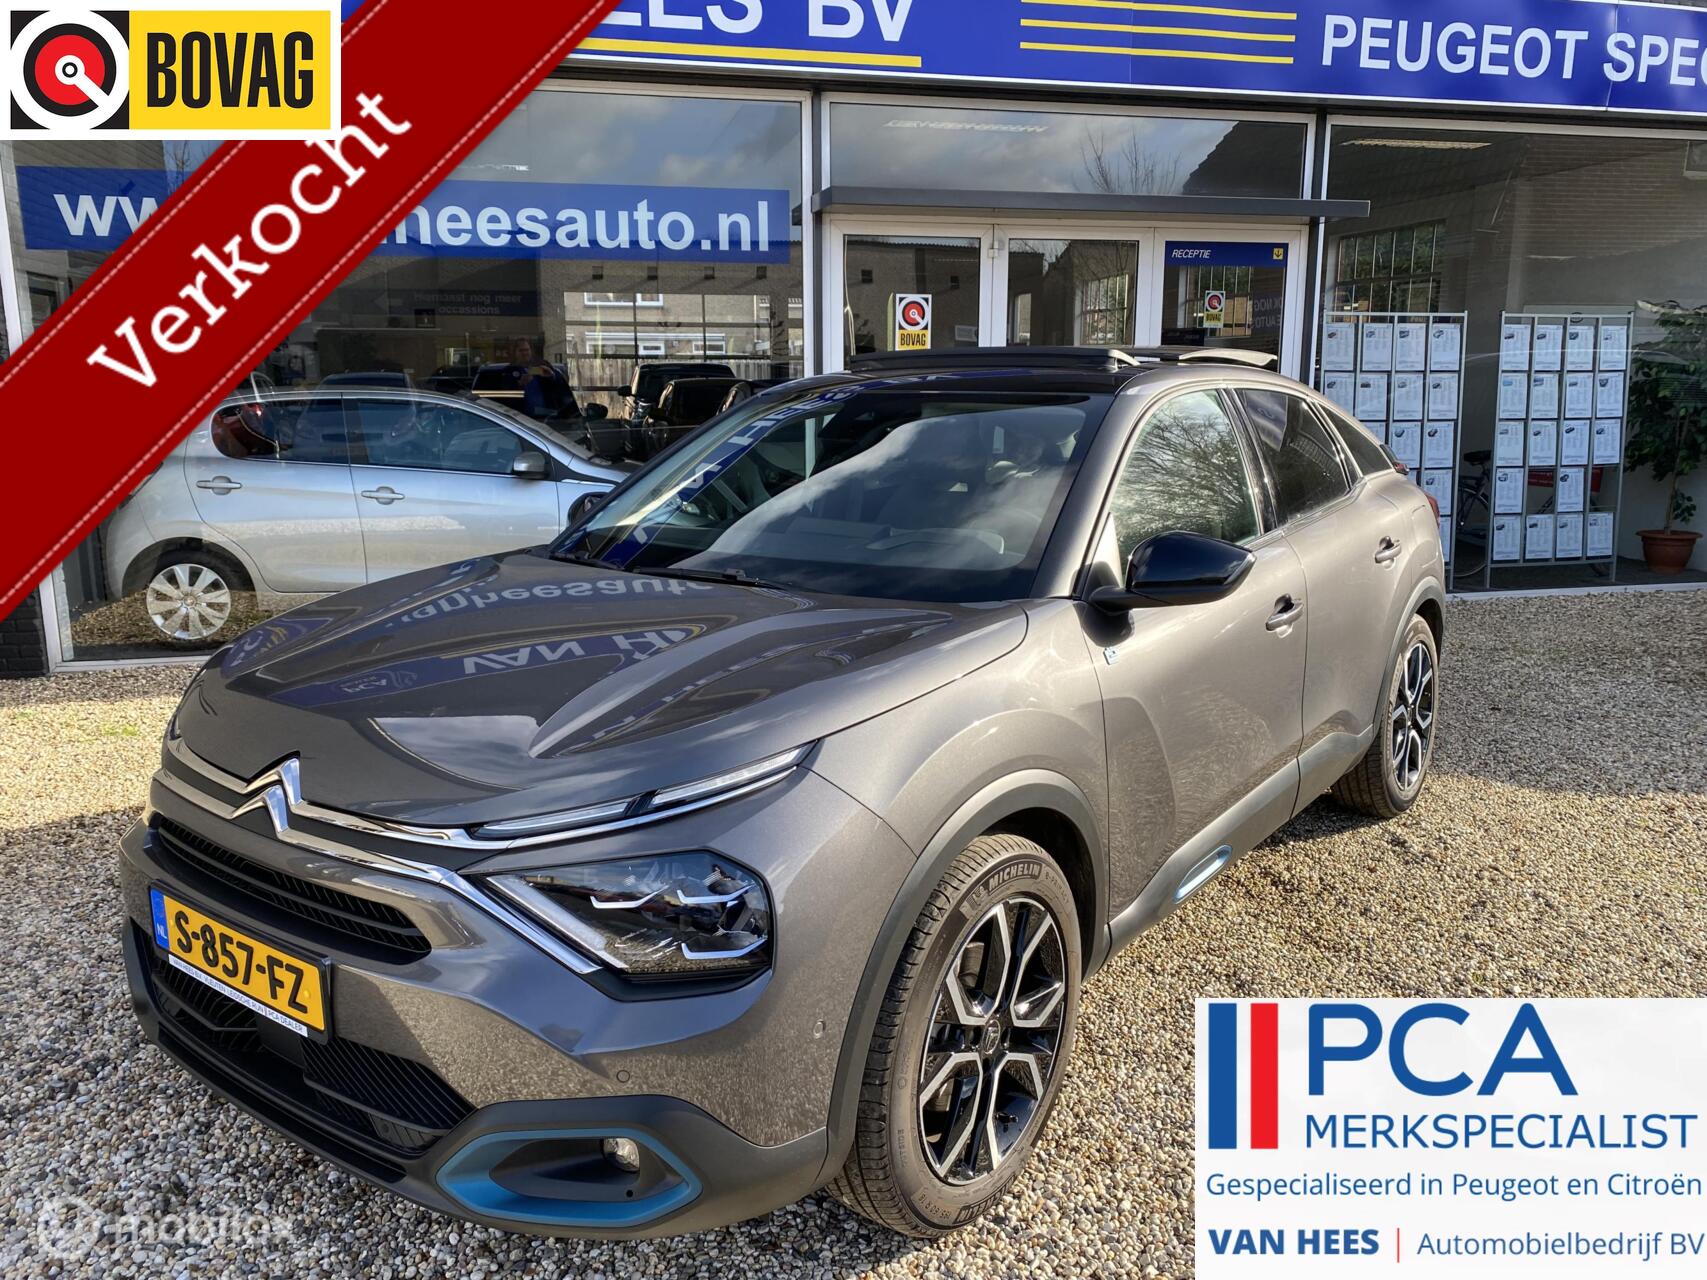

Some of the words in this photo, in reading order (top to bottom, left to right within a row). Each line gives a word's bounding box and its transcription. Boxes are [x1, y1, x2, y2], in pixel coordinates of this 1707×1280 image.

[1321, 14, 1589, 80] PEUGEOT
[1603, 32, 1707, 87] SPE
[1172, 249, 1211, 259] RECEPTIE
[900, 333, 926, 346] BOVAG
[988, 863, 1041, 891] MICHELIN
[156, 923, 167, 939] NL
[175, 910, 308, 1014] S-857-FZ
